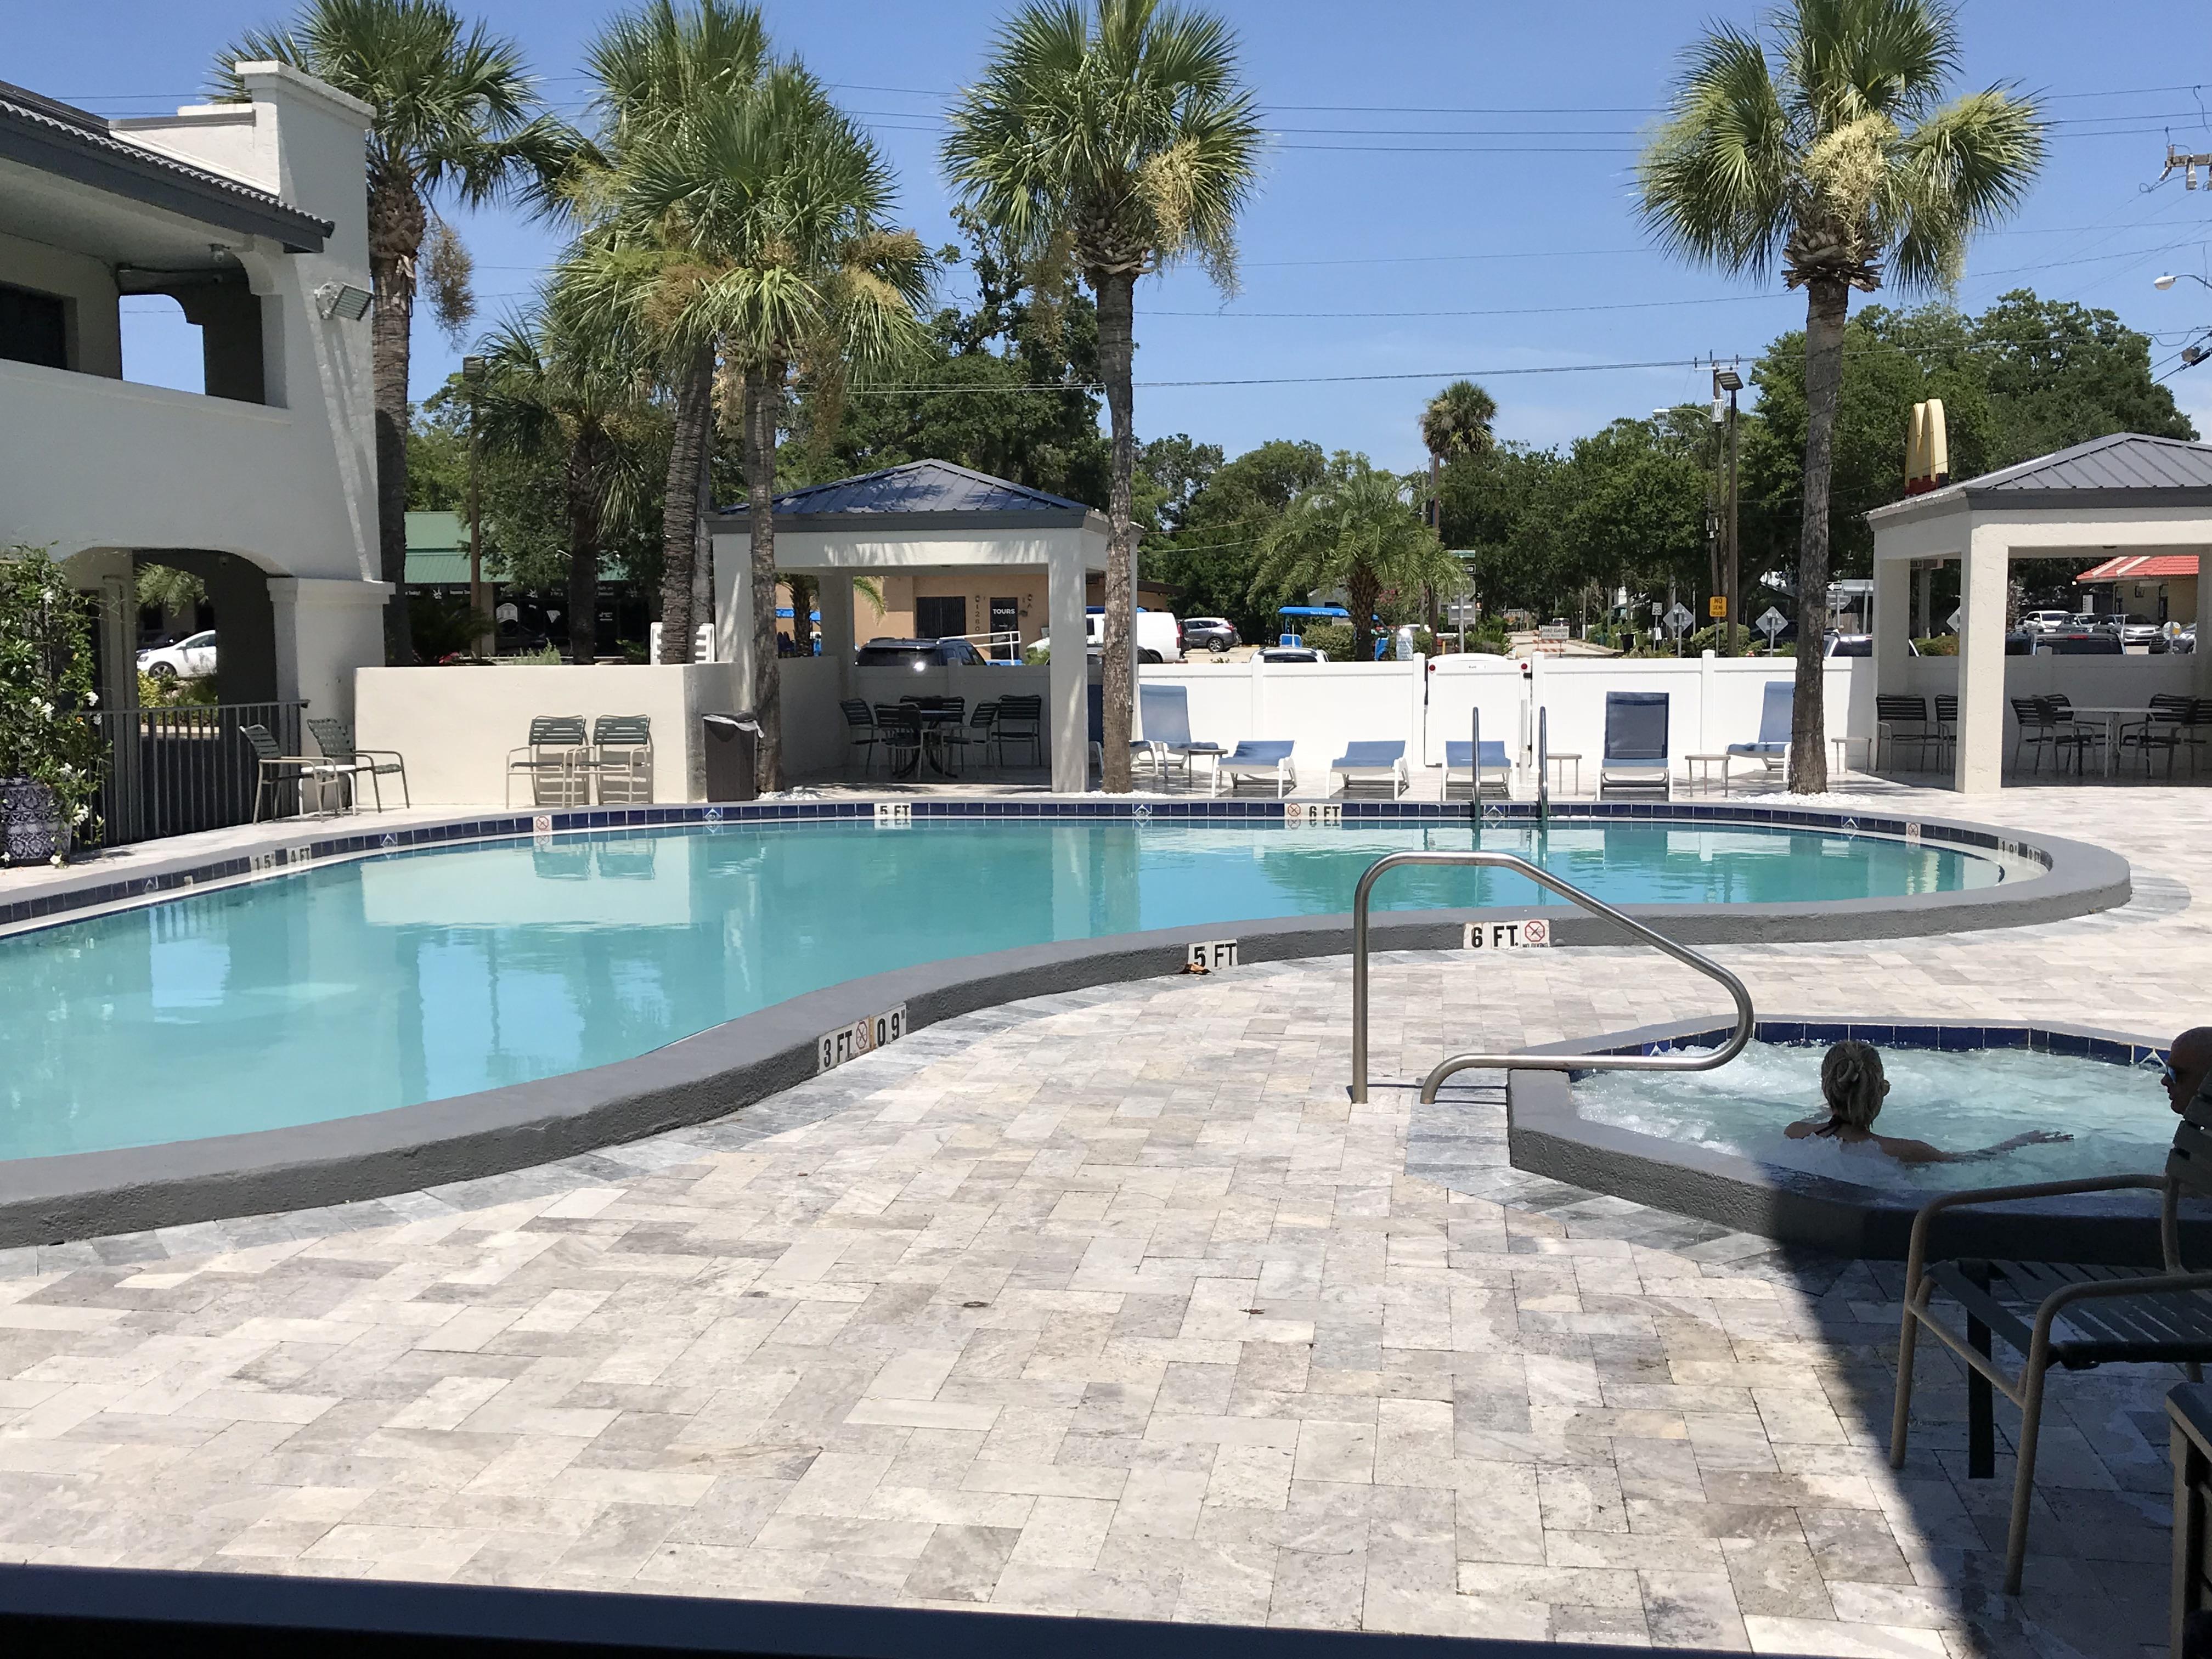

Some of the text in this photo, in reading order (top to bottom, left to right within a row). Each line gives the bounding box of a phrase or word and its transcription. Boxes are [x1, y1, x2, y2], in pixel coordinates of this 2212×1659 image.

[879, 805, 910, 816] 5 FT
[1309, 806, 1340, 817] 6 FT
[300, 848, 309, 861] FT
[1471, 927, 1483, 948] 6
[1194, 943, 1237, 967] 5 FT
[823, 1038, 831, 1068] 3
[837, 1029, 853, 1063] FT
